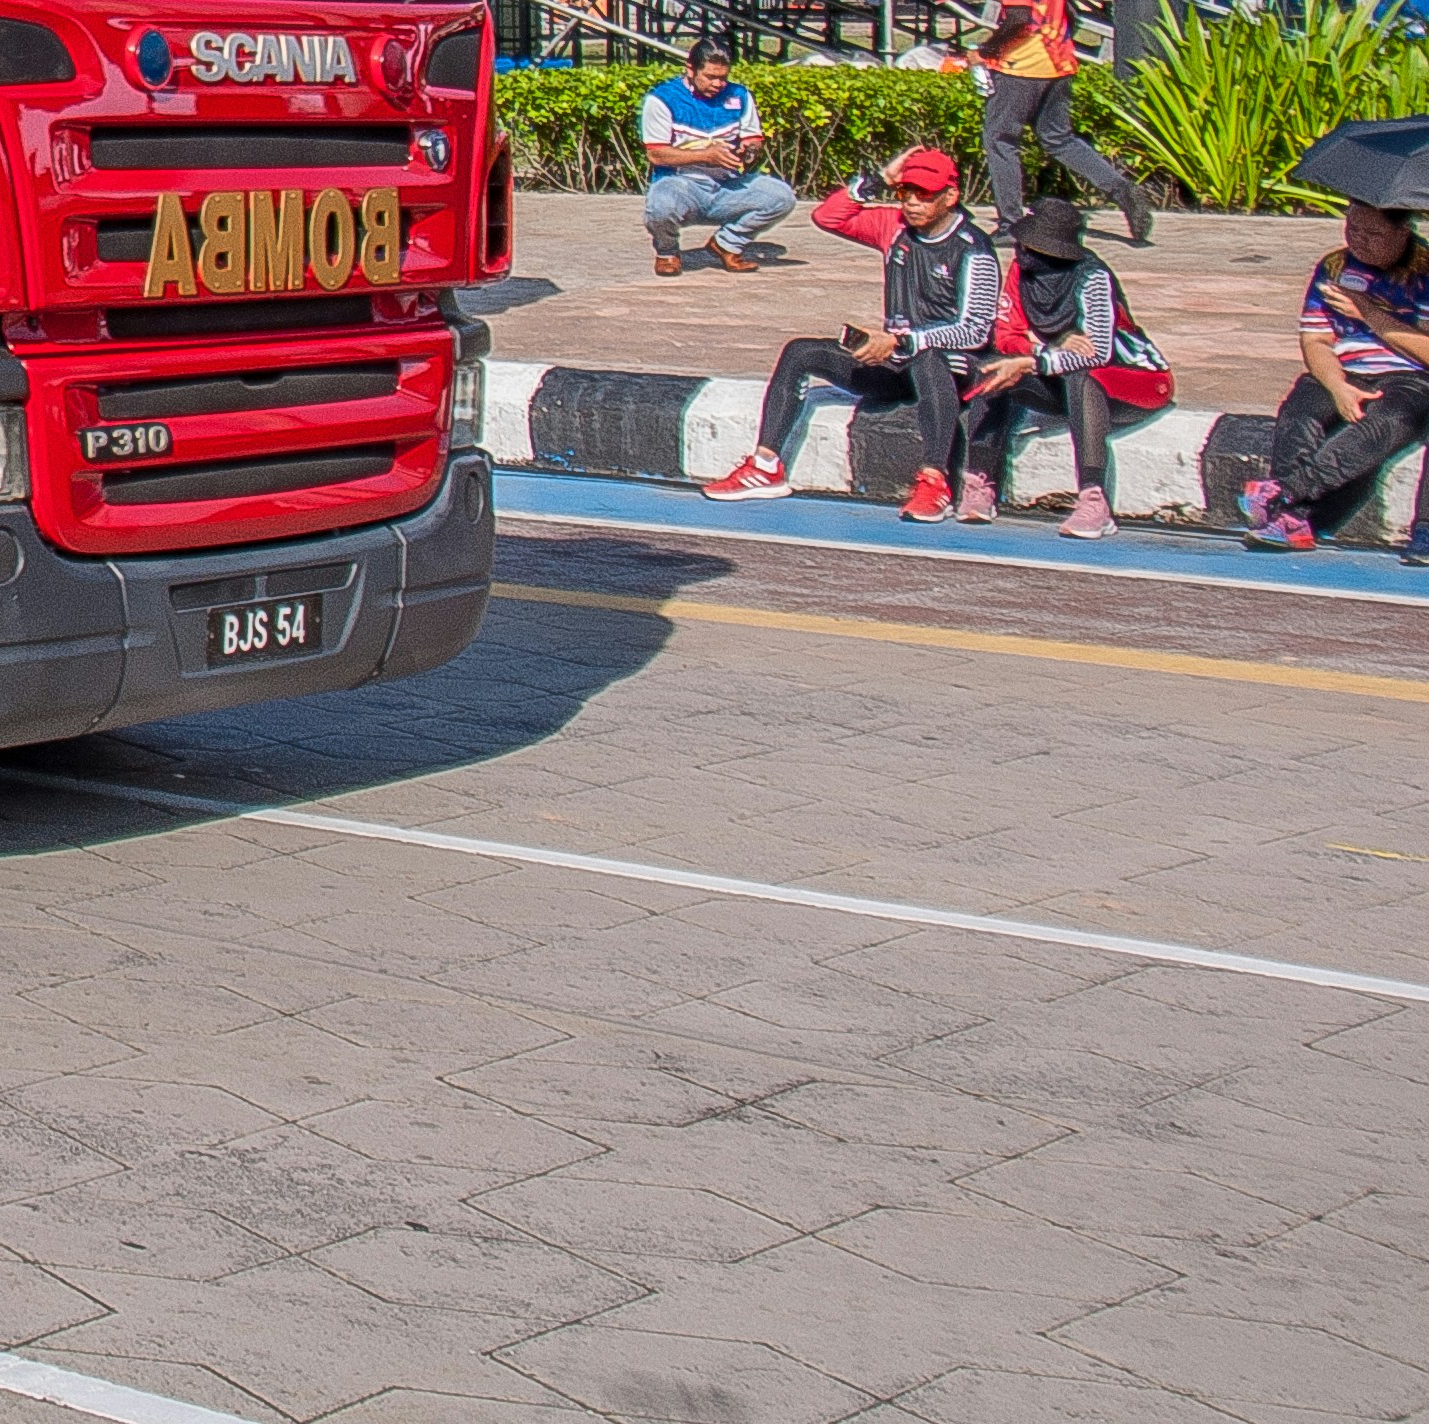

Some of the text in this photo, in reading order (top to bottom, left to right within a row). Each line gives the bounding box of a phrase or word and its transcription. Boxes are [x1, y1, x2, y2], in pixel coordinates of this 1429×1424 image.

[190, 31, 357, 84] SCANIA
[222, 604, 307, 656] BJS 54
